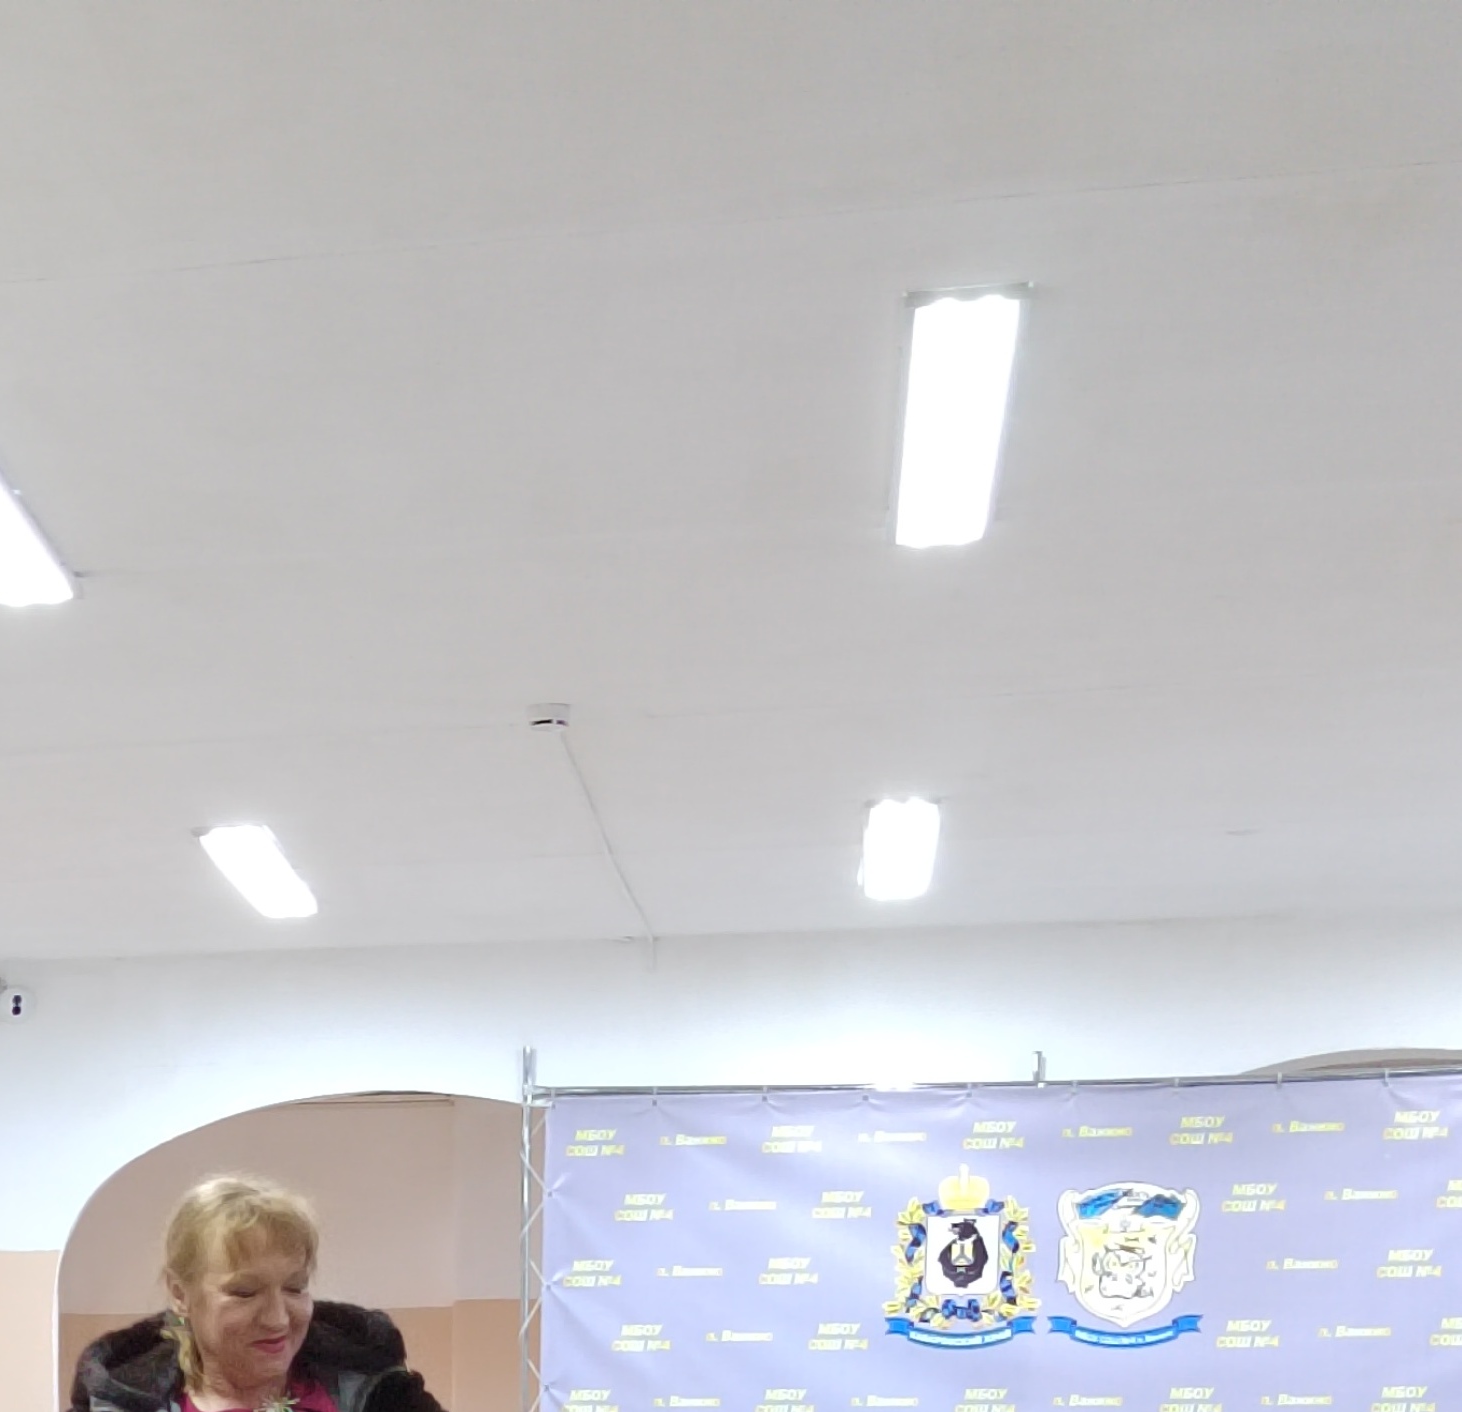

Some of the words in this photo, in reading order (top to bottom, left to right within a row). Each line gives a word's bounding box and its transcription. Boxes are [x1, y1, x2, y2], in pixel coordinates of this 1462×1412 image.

[1180, 1116, 1224, 1128] МБОУ
[1393, 1112, 1439, 1123] МБОУ
[974, 1122, 1016, 1133] МБОУ
[1171, 1133, 1204, 1145] СОШ
[1384, 1128, 1418, 1140] СОШ
[965, 1138, 997, 1149] СОШ
[1232, 1185, 1276, 1196] МБОУ
[1223, 1201, 1256, 1212] СОШ
[1387, 1250, 1433, 1261] МБОУ
[1377, 1266, 1412, 1278] СОШ
[1226, 1320, 1270, 1331] МБОУ
[1217, 1336, 1250, 1348] СОШ
[965, 1389, 1007, 1400] МБОУ
[1169, 1388, 1213, 1399] МБОУ
[1381, 1387, 1427, 1398] МБОУ
